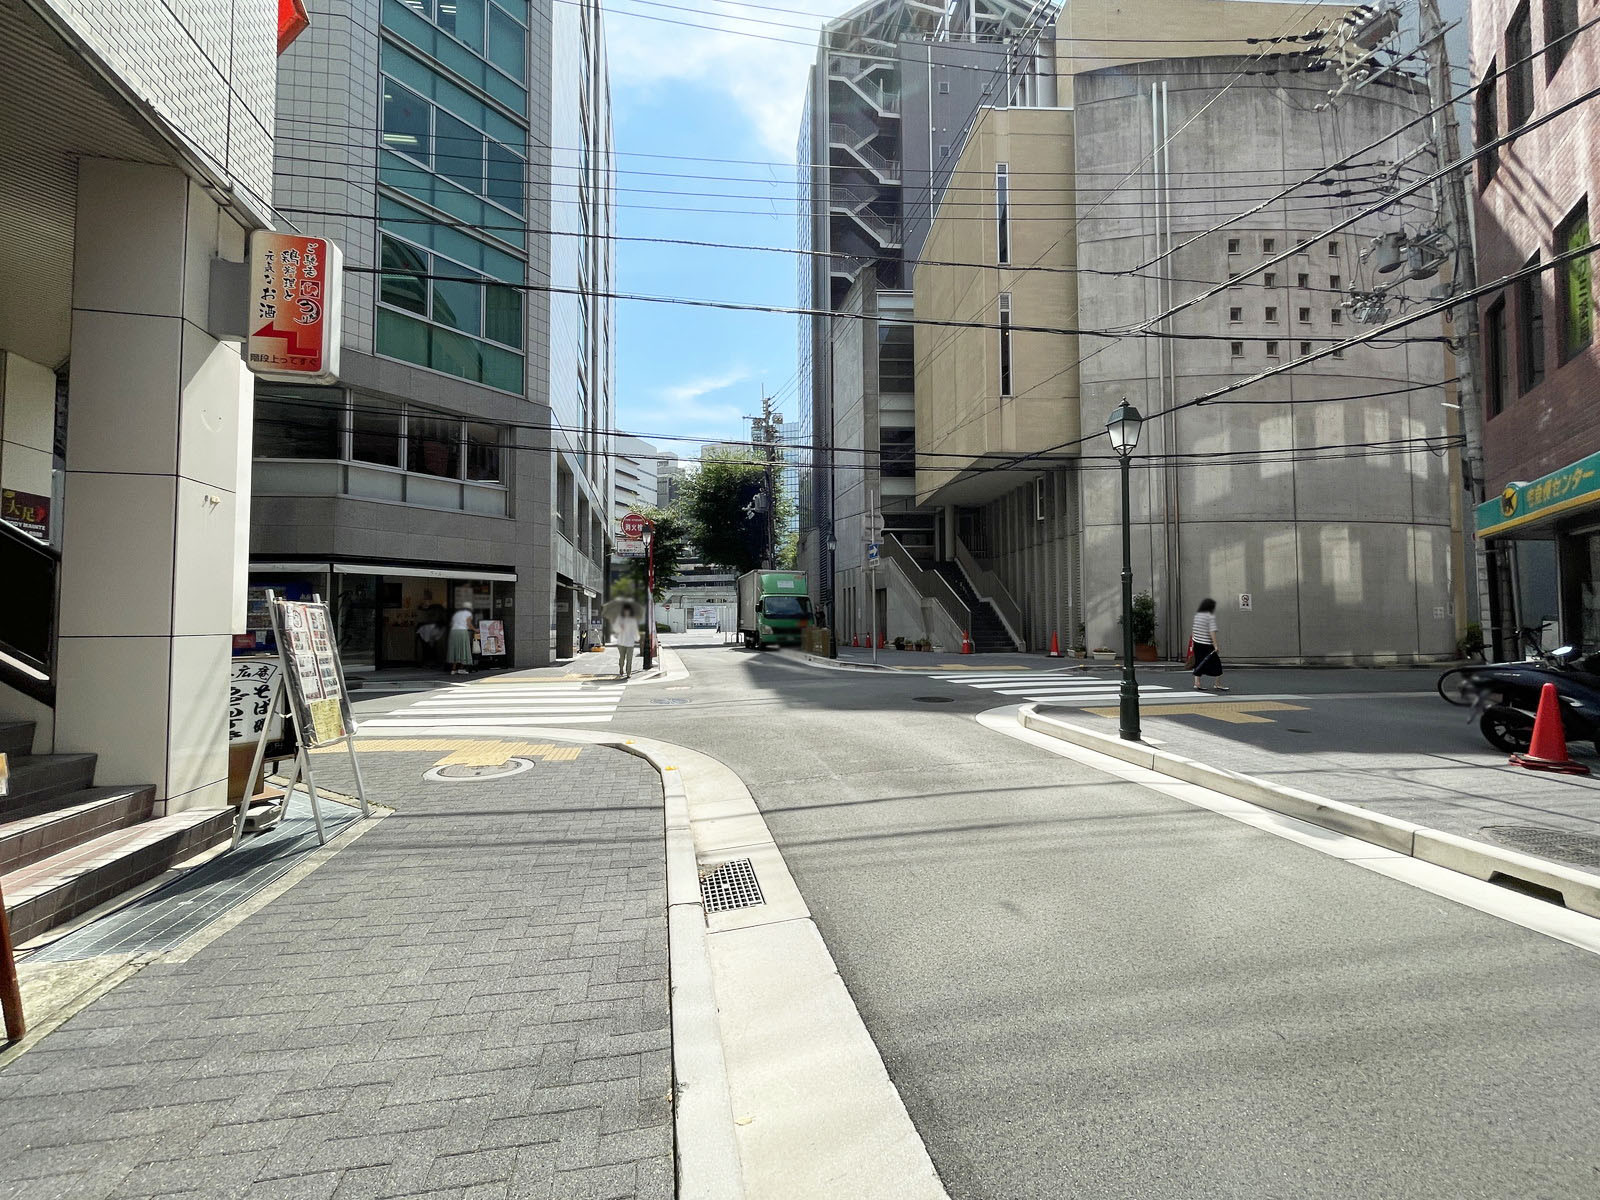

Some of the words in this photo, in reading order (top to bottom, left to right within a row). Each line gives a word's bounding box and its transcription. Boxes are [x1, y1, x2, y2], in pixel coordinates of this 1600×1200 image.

[259, 250, 277, 320] 元気なお酒
[281, 247, 301, 301] 鶏料理と
[250, 353, 317, 366] 階段上ってすぐ
